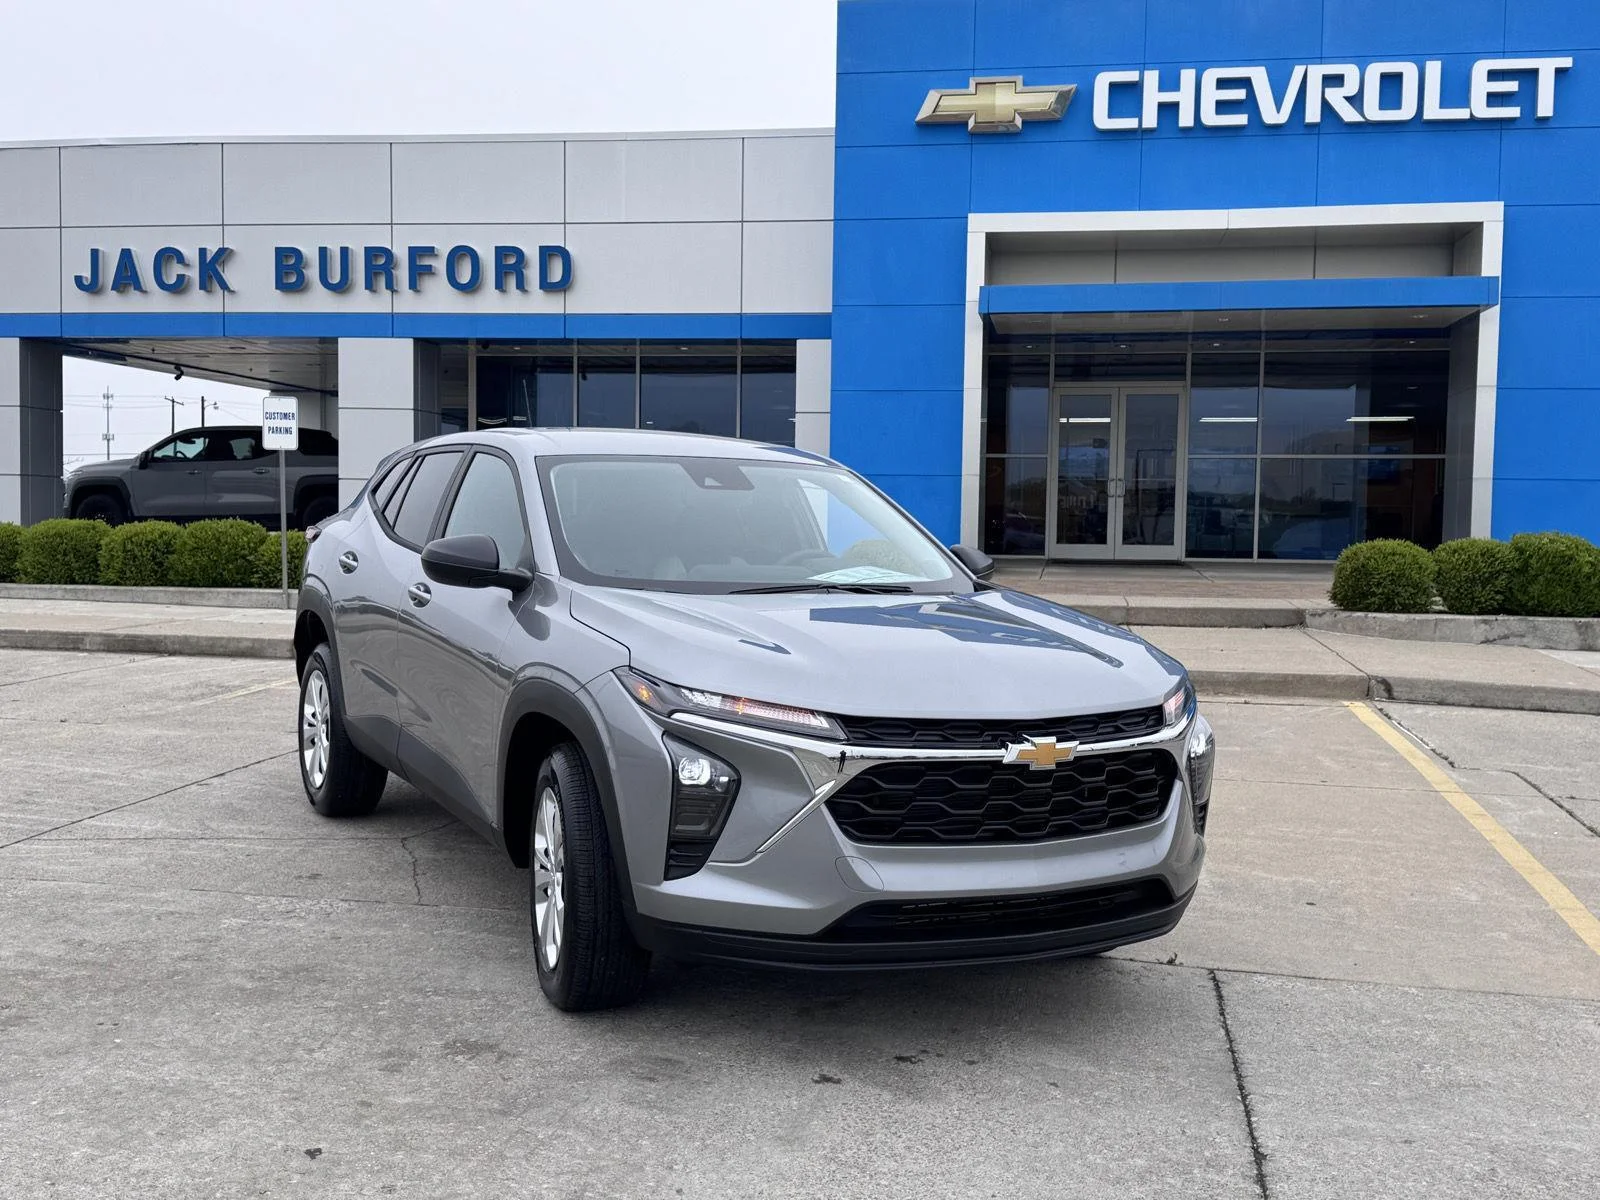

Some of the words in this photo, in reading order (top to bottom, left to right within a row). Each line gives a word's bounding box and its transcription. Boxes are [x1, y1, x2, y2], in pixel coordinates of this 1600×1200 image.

[1092, 56, 1573, 131] CHEVROLET
[74, 246, 235, 293] JACK
[274, 245, 574, 292] BURFORD
[264, 411, 296, 421] CUSTOMER
[267, 426, 293, 435] PARKING
